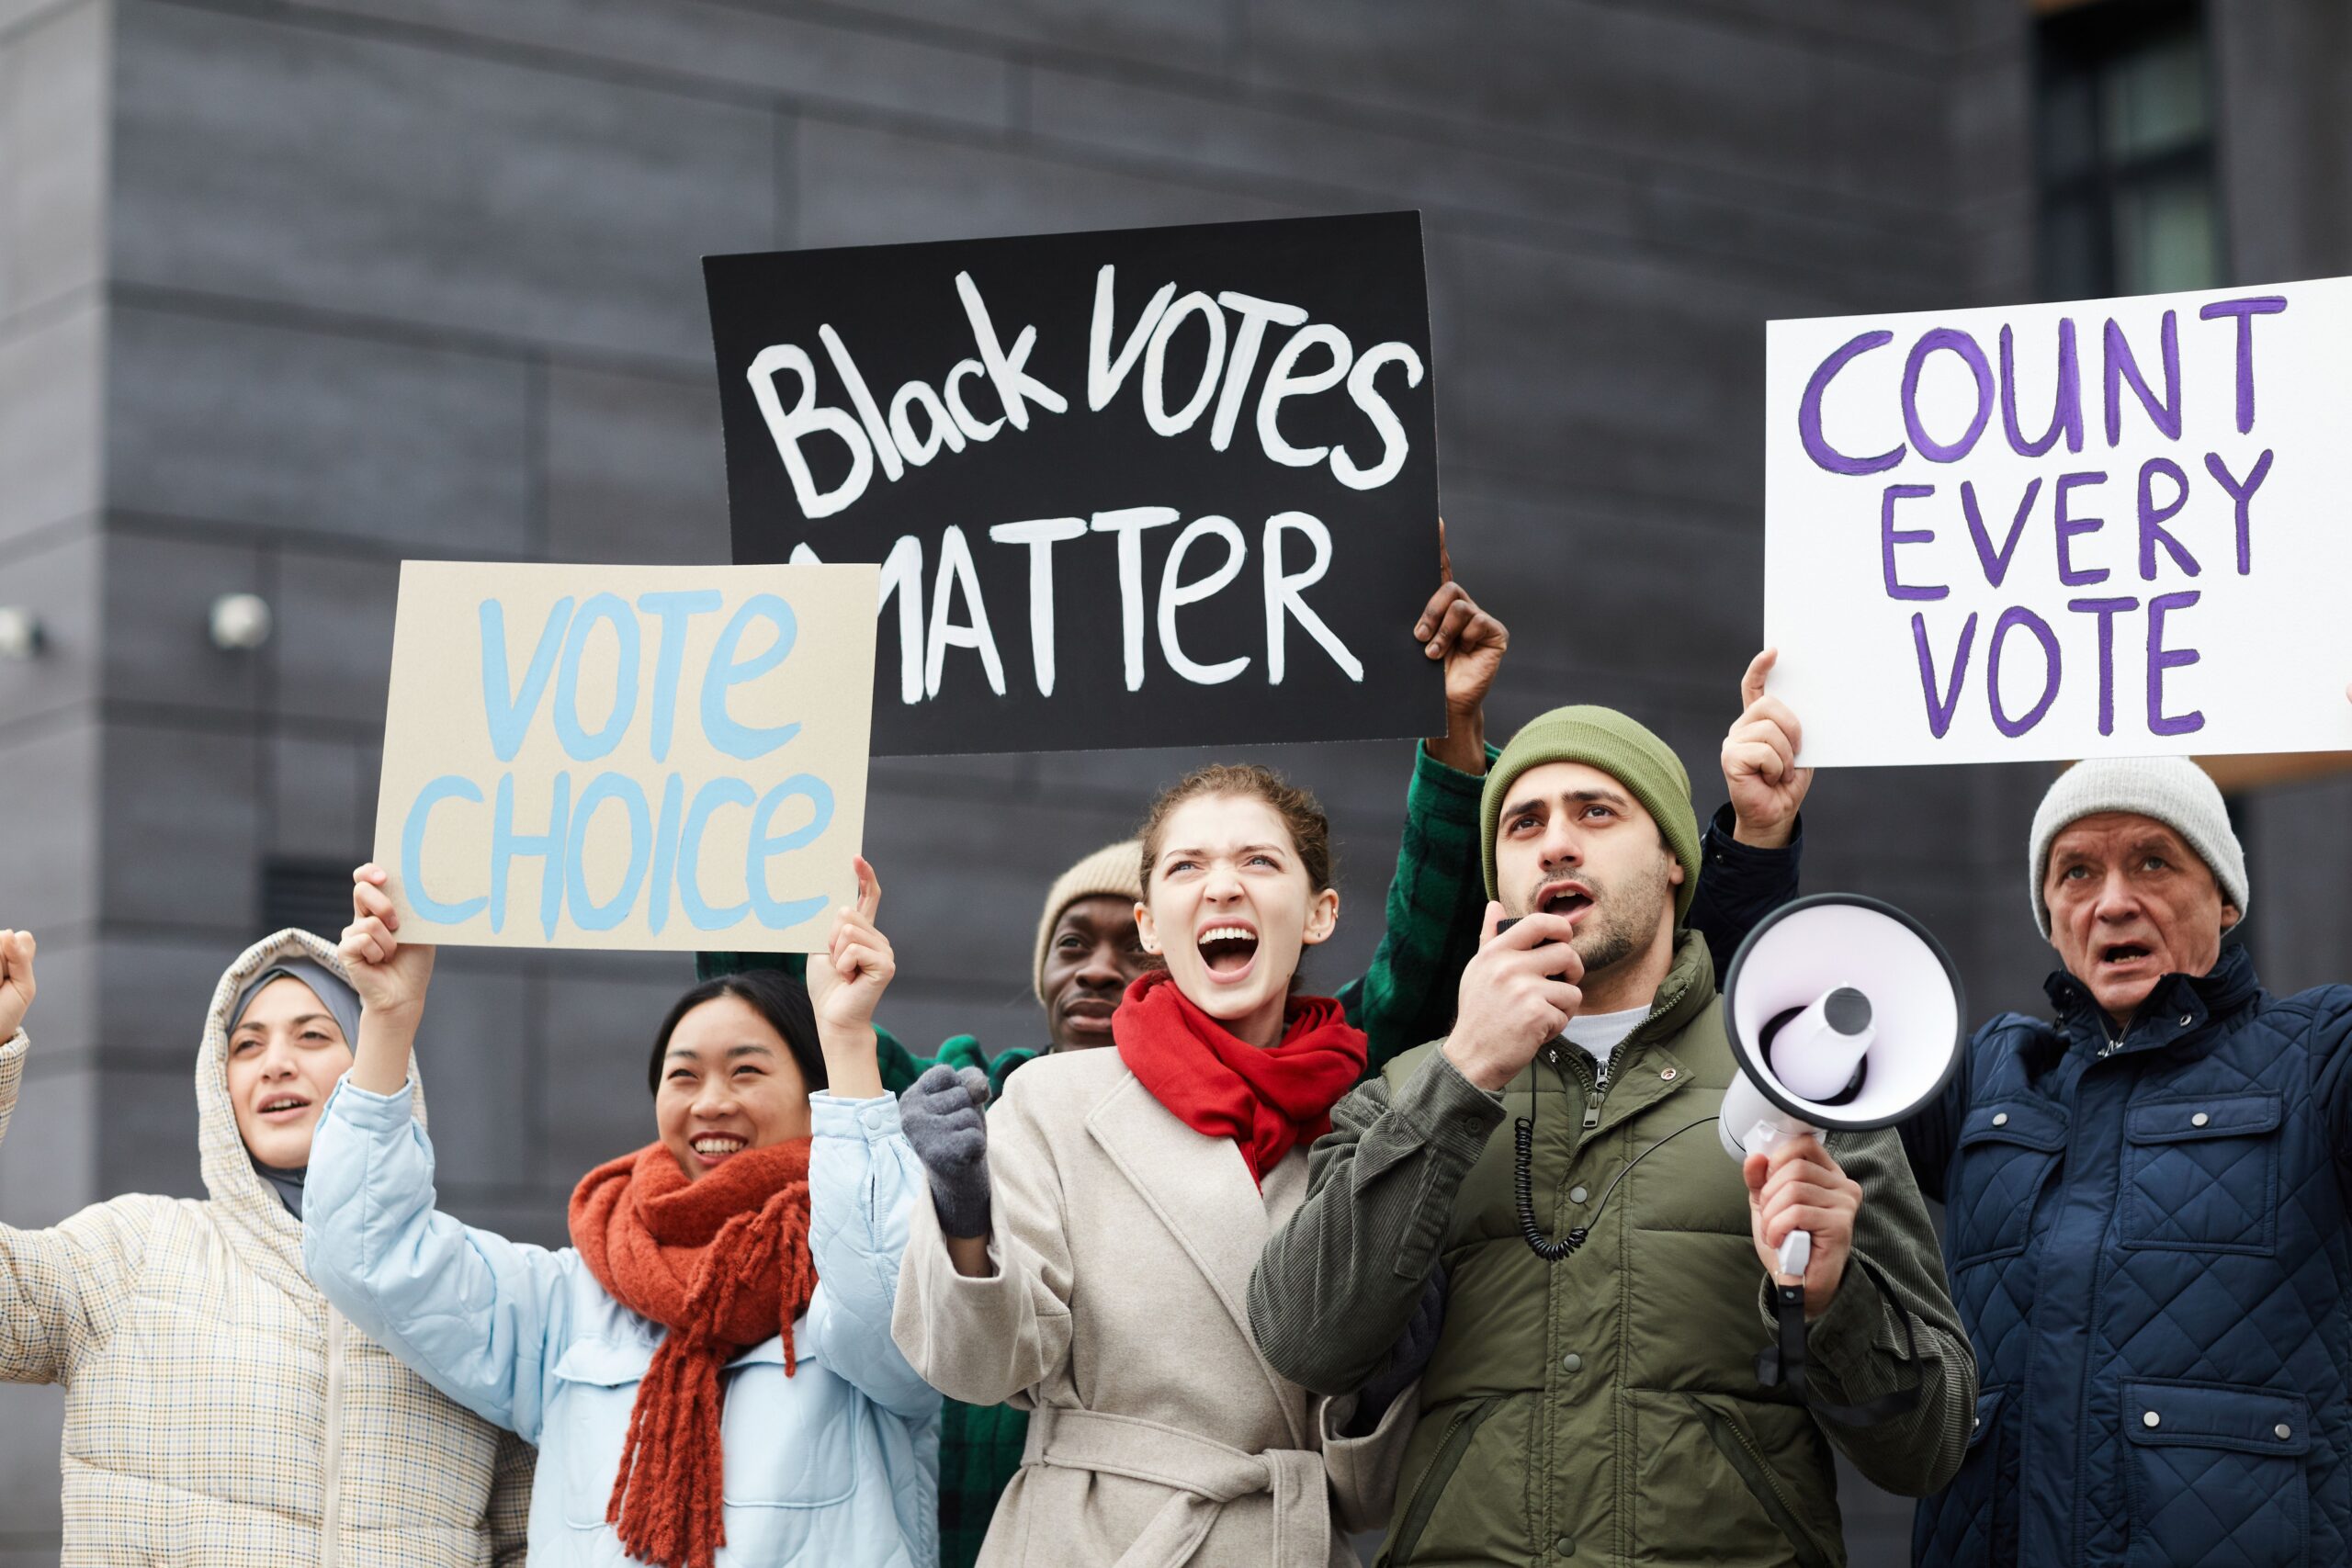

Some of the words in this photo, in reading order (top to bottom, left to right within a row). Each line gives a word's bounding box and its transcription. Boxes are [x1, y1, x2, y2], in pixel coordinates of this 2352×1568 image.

[747, 271, 1068, 519] Black
[1798, 296, 2288, 476] COUNT
[1882, 448, 2274, 601] EVERY
[1911, 591, 2205, 739] VOTE
